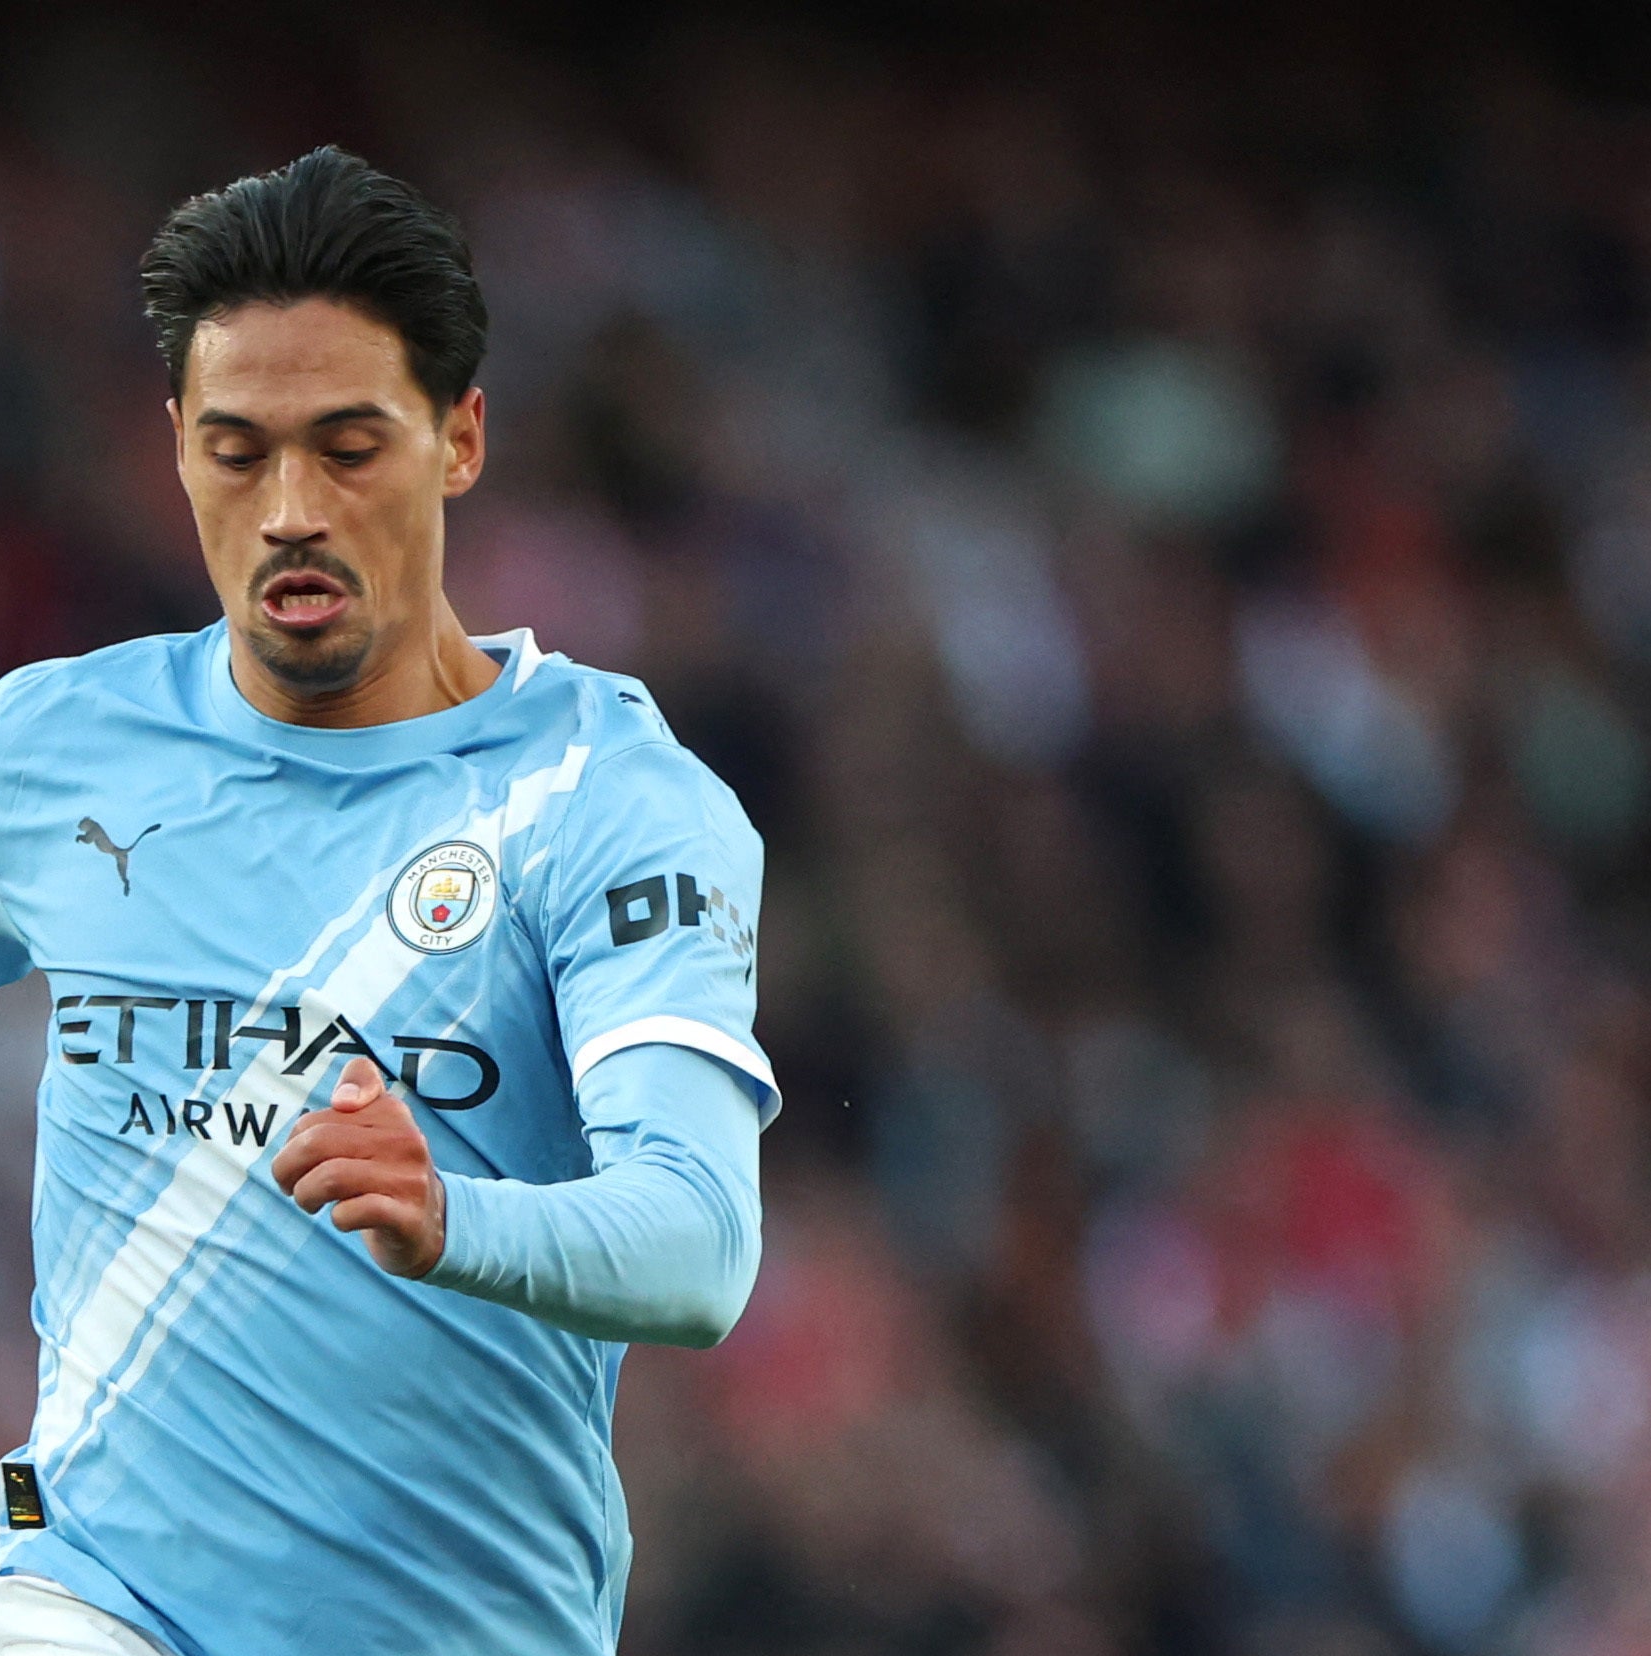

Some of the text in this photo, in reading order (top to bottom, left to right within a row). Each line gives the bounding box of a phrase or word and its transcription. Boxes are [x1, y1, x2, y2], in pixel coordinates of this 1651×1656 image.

[407, 850, 491, 884] MANCHESTER
[419, 934, 453, 946] CITY
[57, 994, 501, 1111] ETIHAD
[118, 1092, 311, 1148] AIRW
